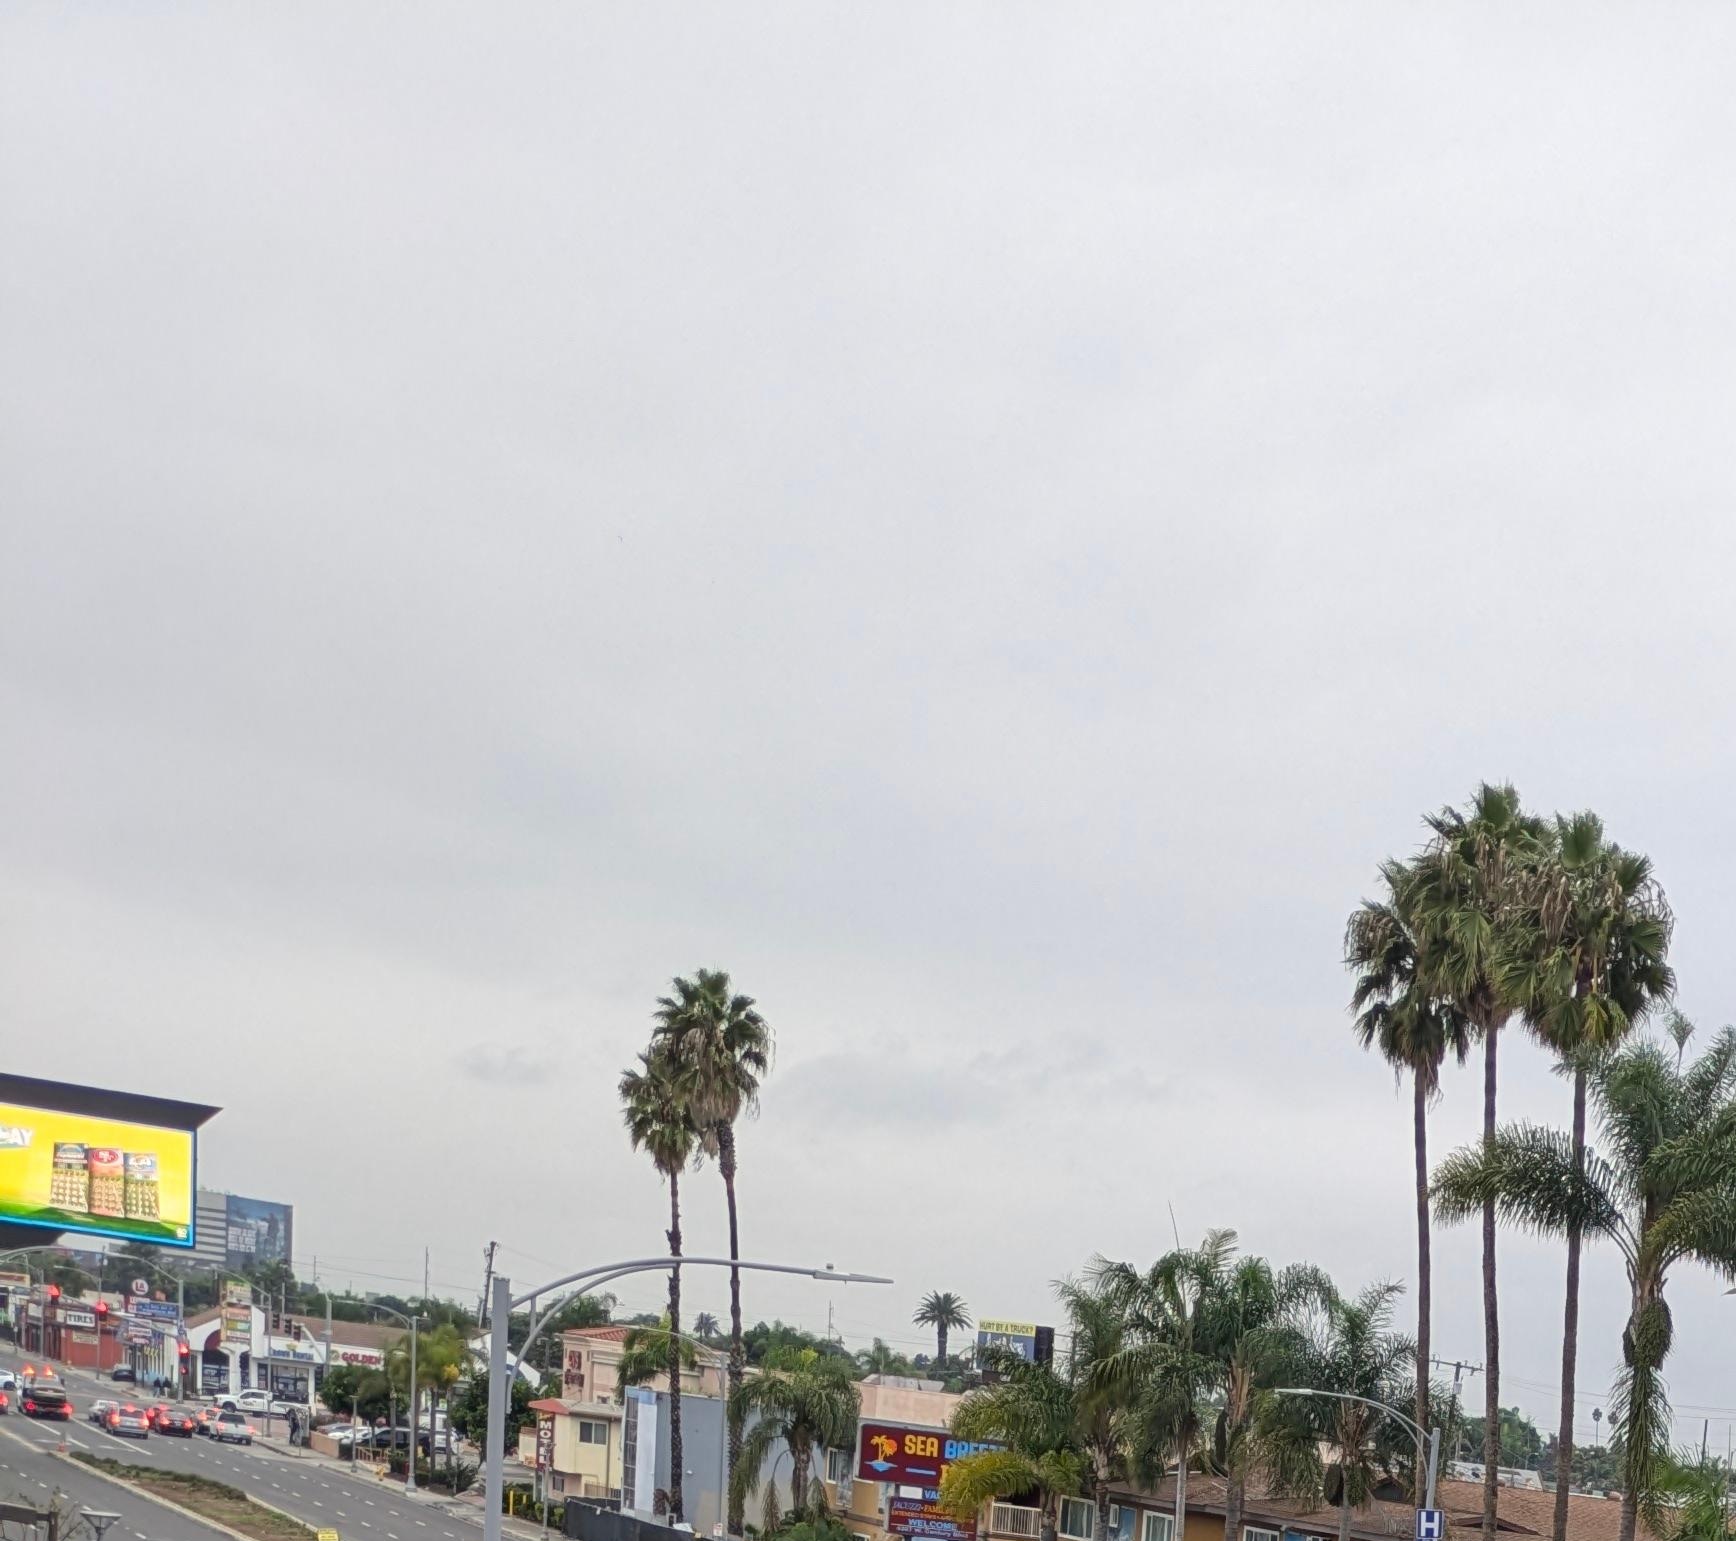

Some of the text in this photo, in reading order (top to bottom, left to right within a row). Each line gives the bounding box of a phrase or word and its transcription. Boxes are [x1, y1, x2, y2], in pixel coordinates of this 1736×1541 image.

[68, 1312, 94, 1325] TIRES
[980, 1321, 996, 1331] HURT
[341, 1351, 381, 1365] GOLDEN
[539, 1421, 552, 1465] MOTEL
[904, 1434, 939, 1458] SEA
[1420, 1511, 1440, 1538] H
